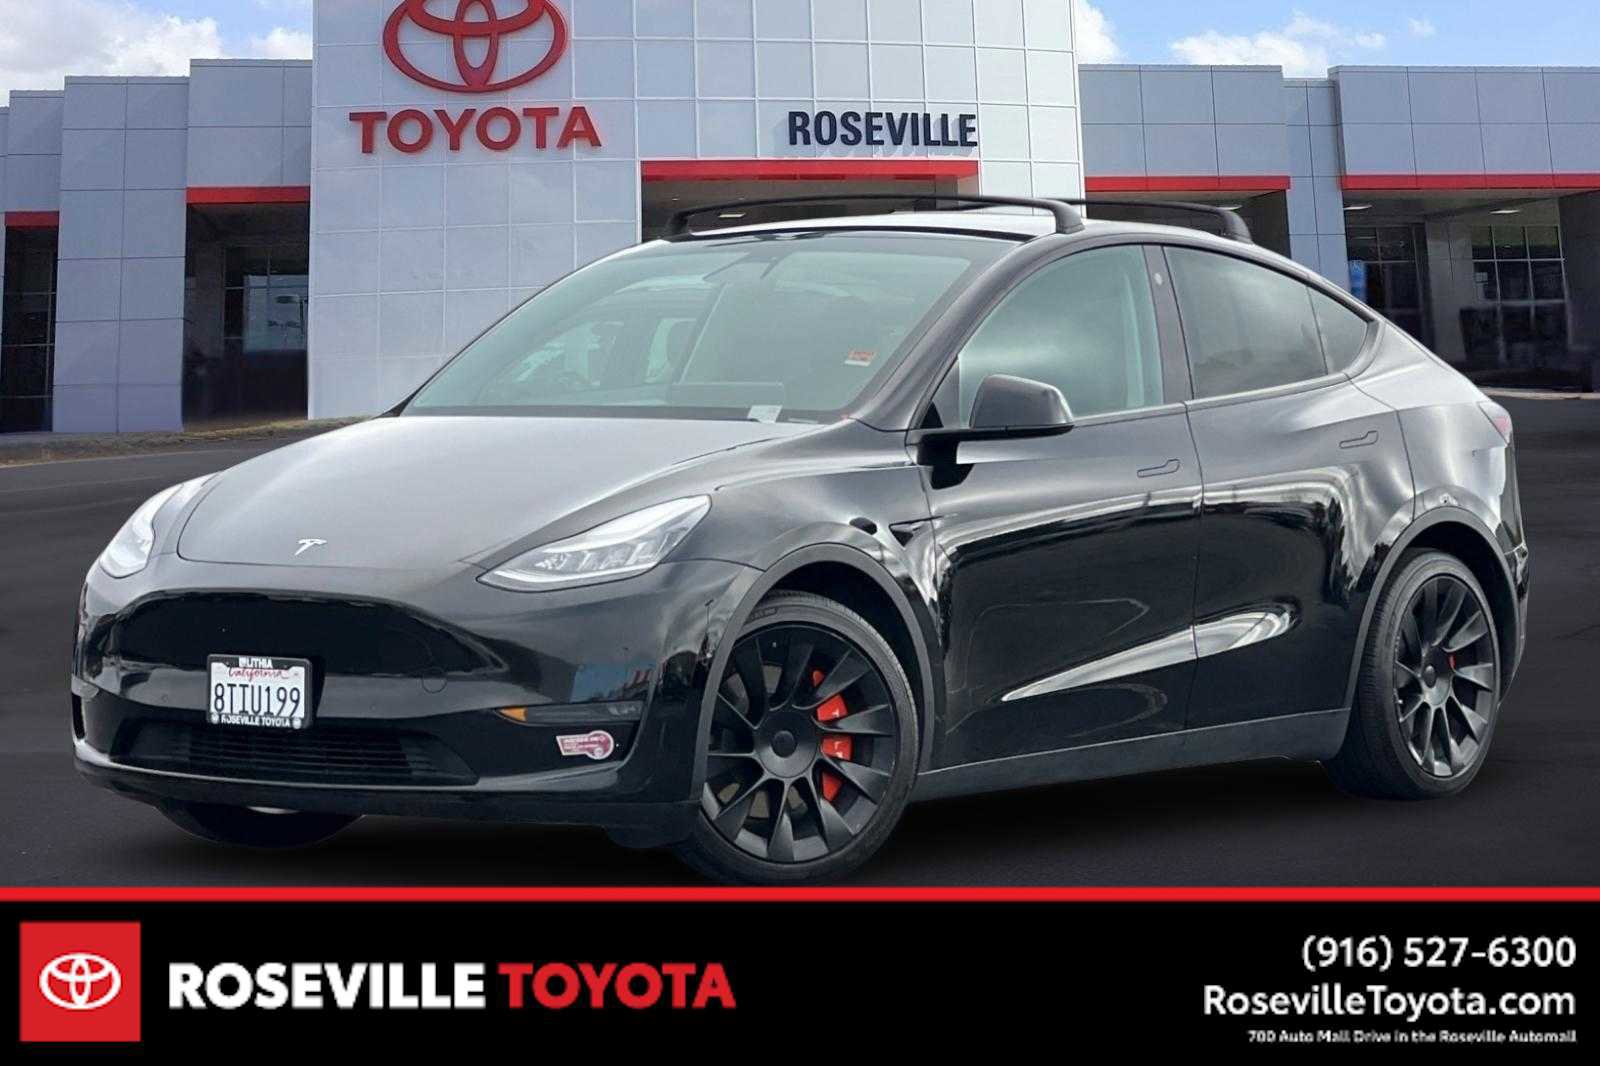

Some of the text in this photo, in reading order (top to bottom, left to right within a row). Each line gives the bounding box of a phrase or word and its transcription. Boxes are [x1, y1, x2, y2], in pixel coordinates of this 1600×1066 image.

[350, 106, 603, 154] TOYOTA
[788, 111, 979, 147] ROSEVILLE
[214, 683, 301, 717] 8TIU199
[221, 714, 291, 728] ROSEVILLE TOYOTA
